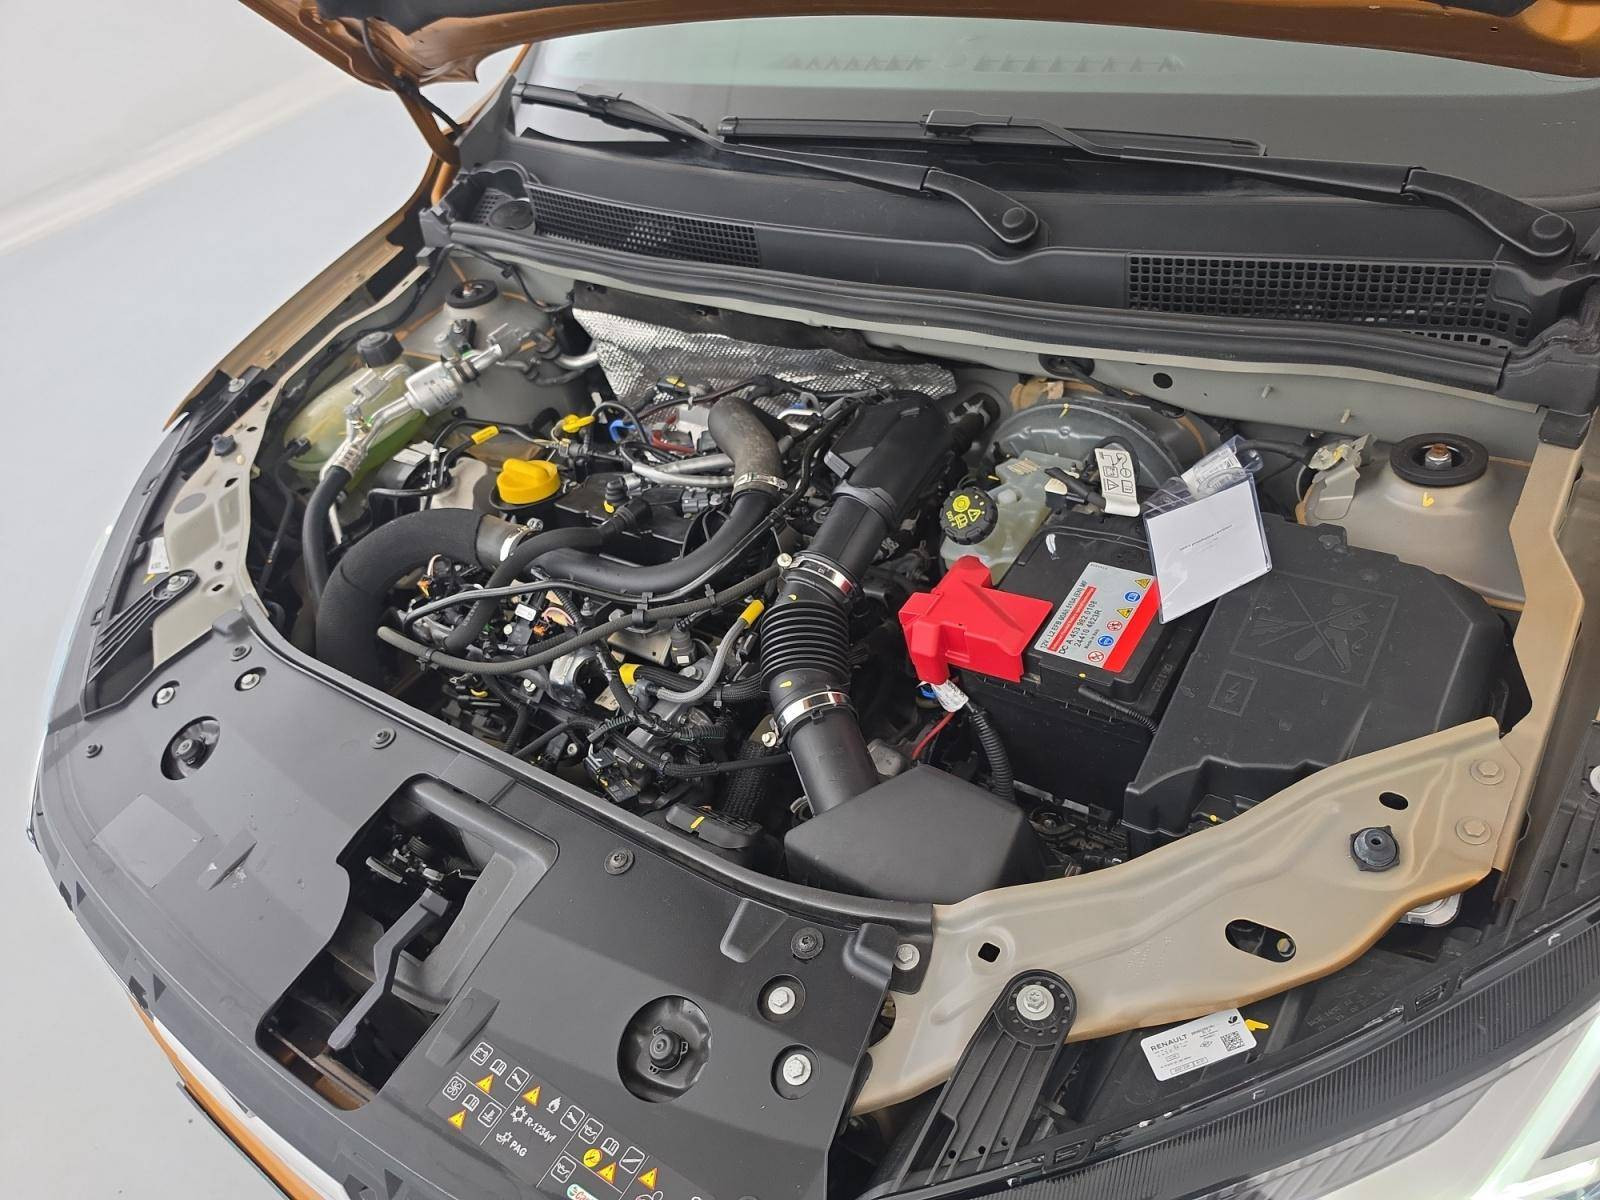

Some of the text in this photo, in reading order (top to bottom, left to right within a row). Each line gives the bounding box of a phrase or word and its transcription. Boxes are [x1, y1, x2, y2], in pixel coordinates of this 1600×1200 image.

[946, 511, 954, 522] DOT
[1059, 645, 1069, 655] DC
[1070, 627, 1081, 639] 453
[1074, 628, 1090, 648] 24410
[1150, 1034, 1188, 1052] RENAULT
[524, 1116, 557, 1143] R-1234yf
[509, 1140, 528, 1157] PAG
